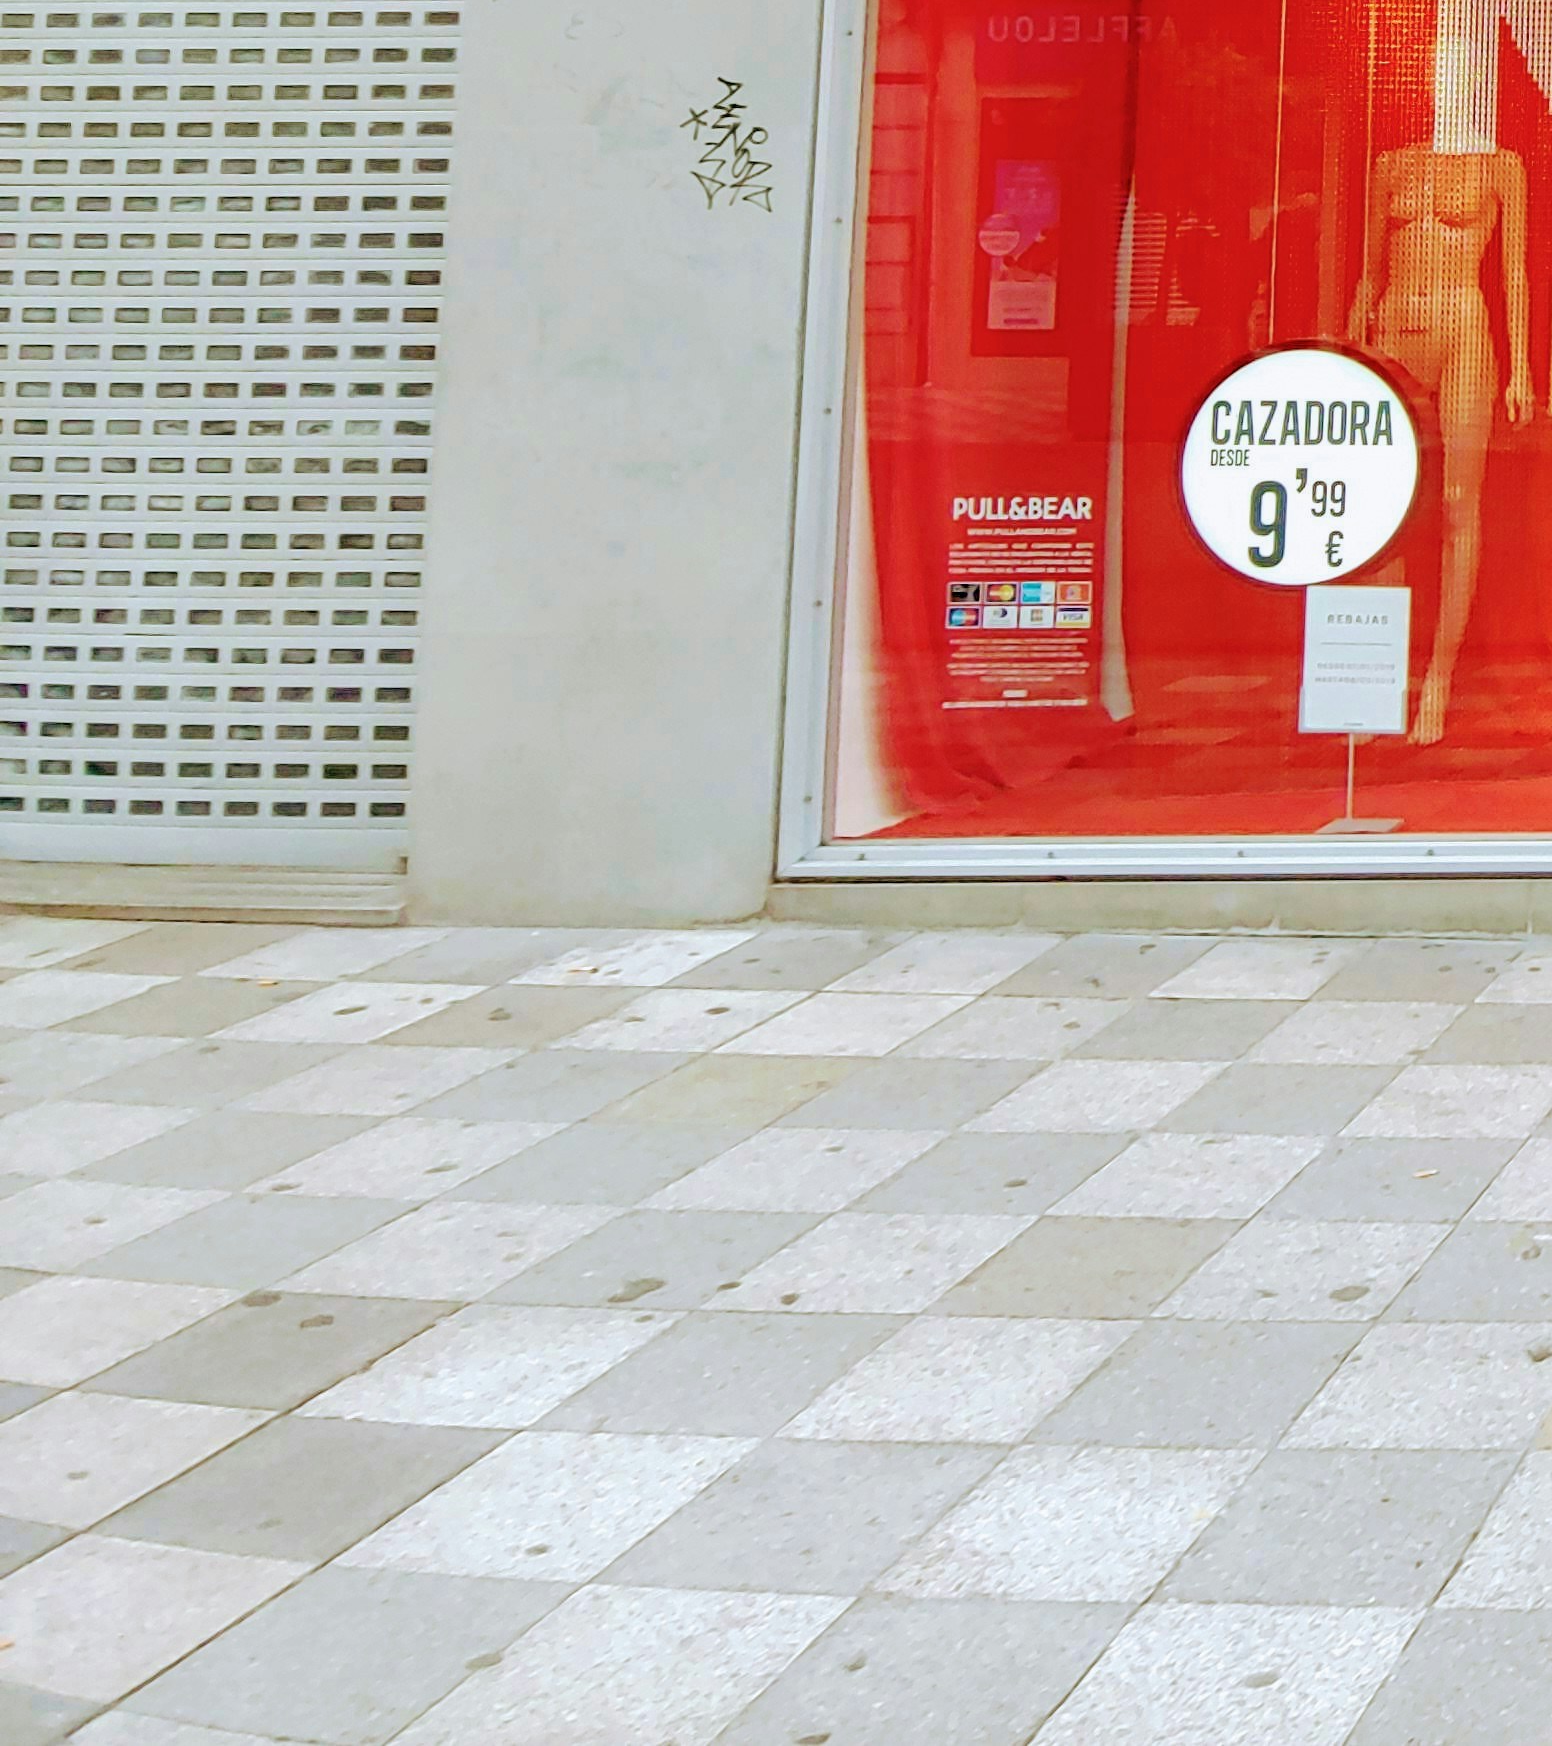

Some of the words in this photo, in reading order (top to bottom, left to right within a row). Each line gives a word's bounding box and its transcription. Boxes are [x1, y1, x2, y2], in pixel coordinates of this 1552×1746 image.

[1211, 400, 1393, 446] CAZADORA
[1210, 449, 1250, 467] DESDE
[953, 496, 1093, 521] PULL&BEAR
[1327, 614, 1388, 625] REBAJAS
